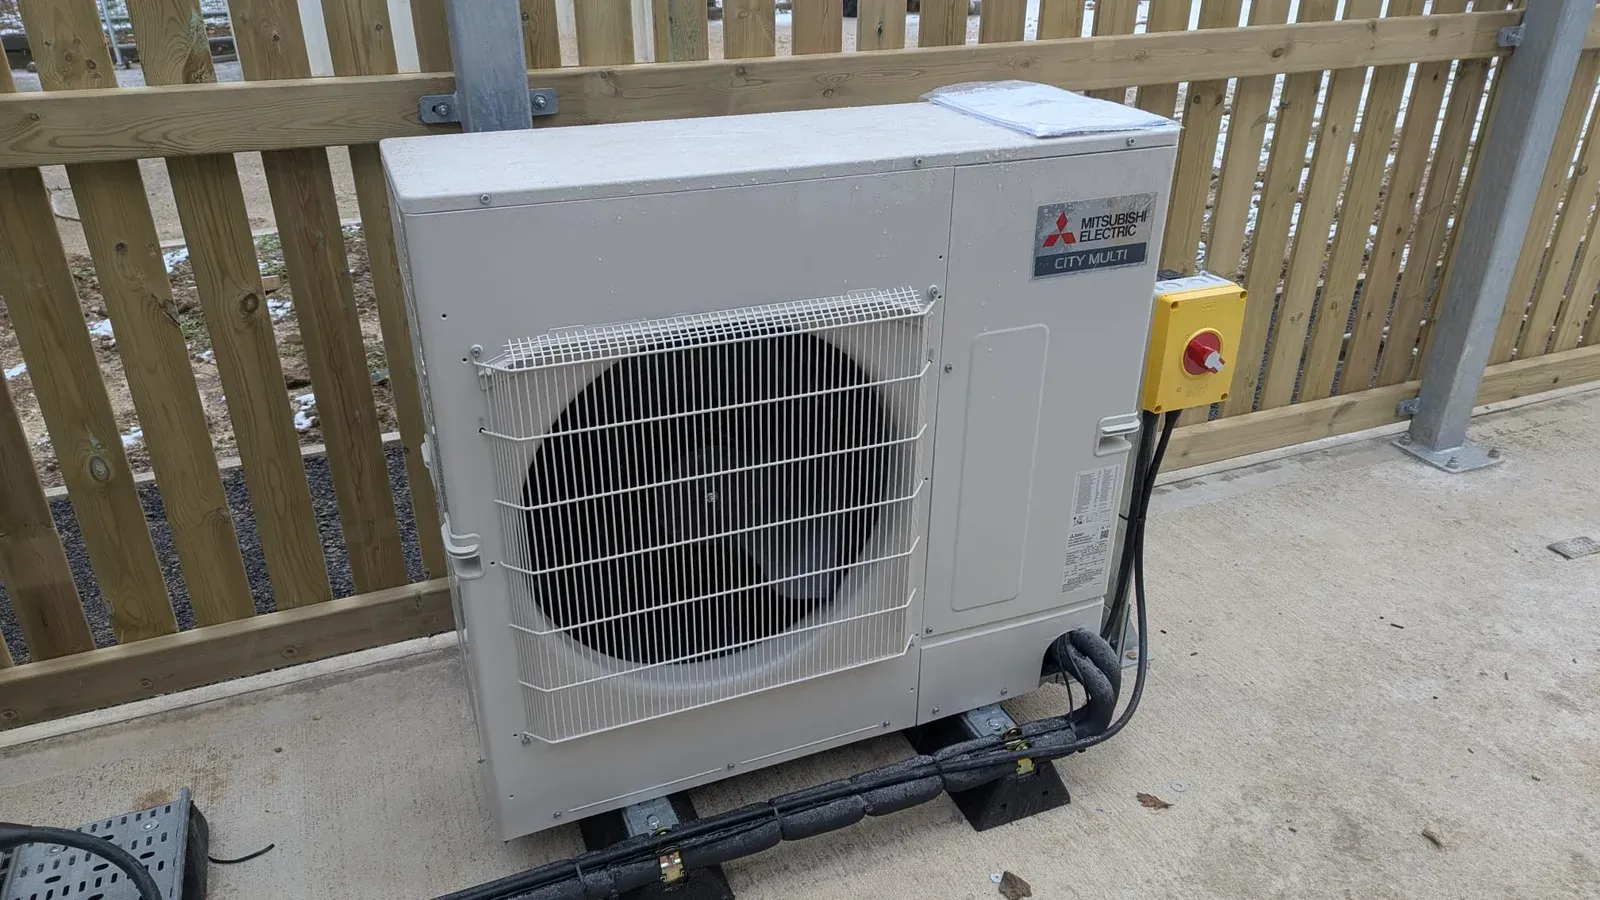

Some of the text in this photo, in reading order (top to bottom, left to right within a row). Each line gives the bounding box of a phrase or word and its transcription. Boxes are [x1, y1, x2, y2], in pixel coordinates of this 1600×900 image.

[1081, 210, 1147, 230] MITSUBISHI
[1079, 224, 1137, 243] ELECTRIC
[1054, 248, 1128, 270] CITY MULTI
